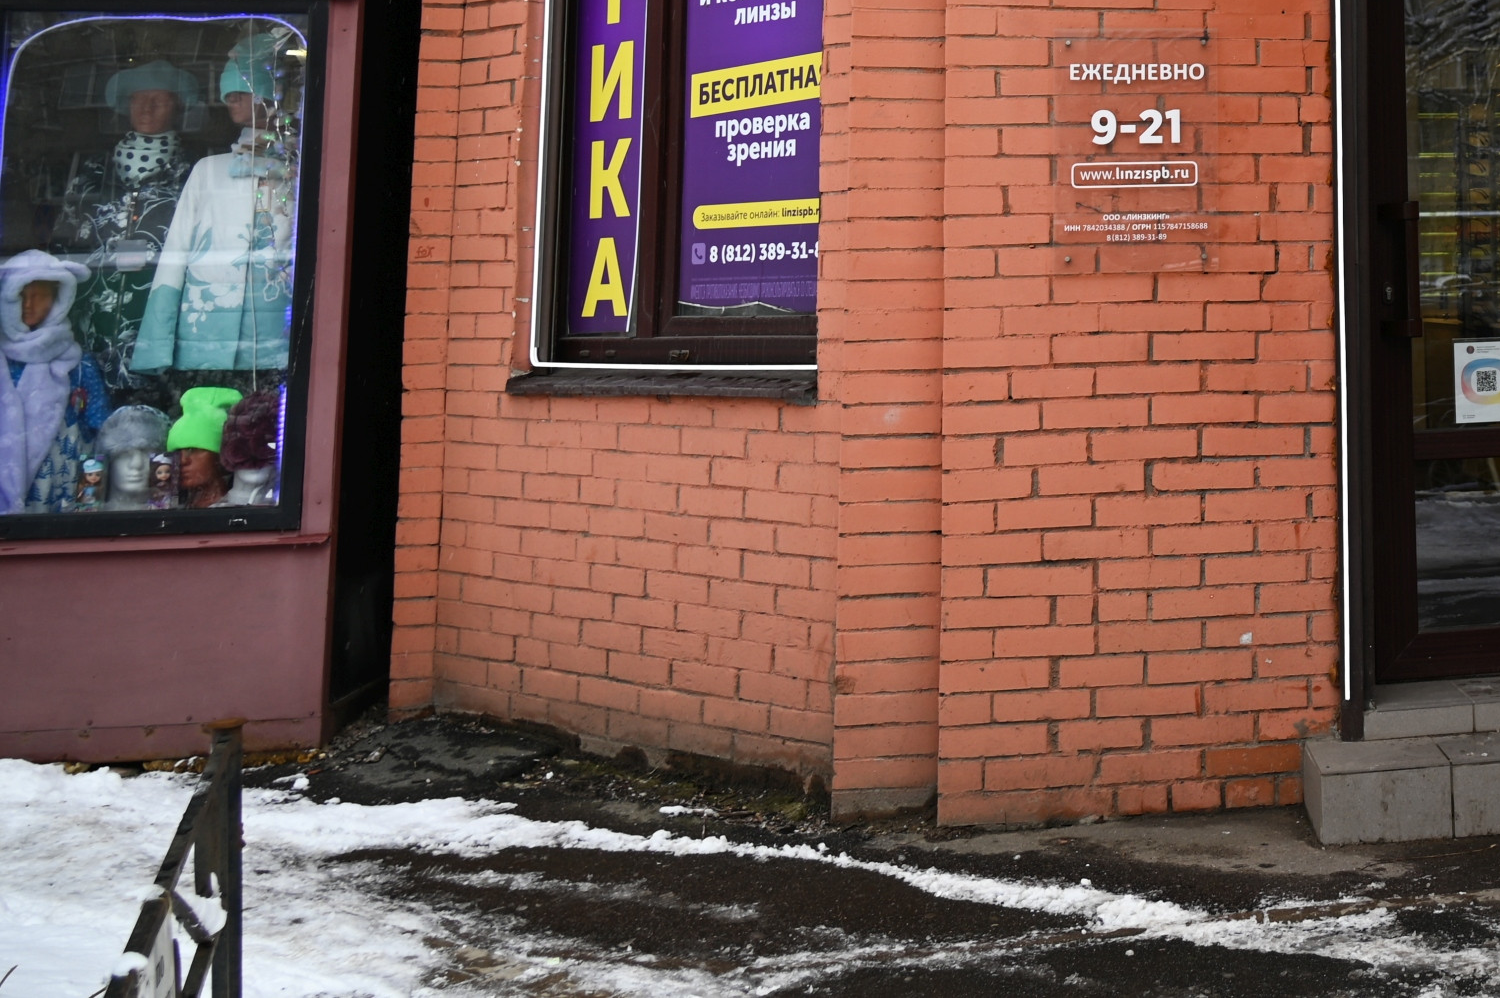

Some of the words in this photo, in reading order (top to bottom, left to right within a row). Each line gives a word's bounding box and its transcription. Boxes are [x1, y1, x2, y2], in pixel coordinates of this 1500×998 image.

[734, 1, 796, 26] линзы
[1069, 63, 1205, 84] ЕЖЕДНЕВНО
[699, 65, 821, 105] БЕСПЛАТНА
[715, 112, 810, 142] проверка
[1091, 109, 1181, 145] 9-21
[727, 139, 796, 167] зрения
[1080, 167, 1189, 182] www.linzispb.ru
[701, 211, 748, 222] Заказывайте
[750, 208, 779, 219] онлайн:
[1122, 213, 1170, 221] «ЛИНЗКИНГ»
[1132, 233, 1167, 241] 389-31-89
[709, 246, 718, 262] 8
[722, 243, 756, 264] (812)
